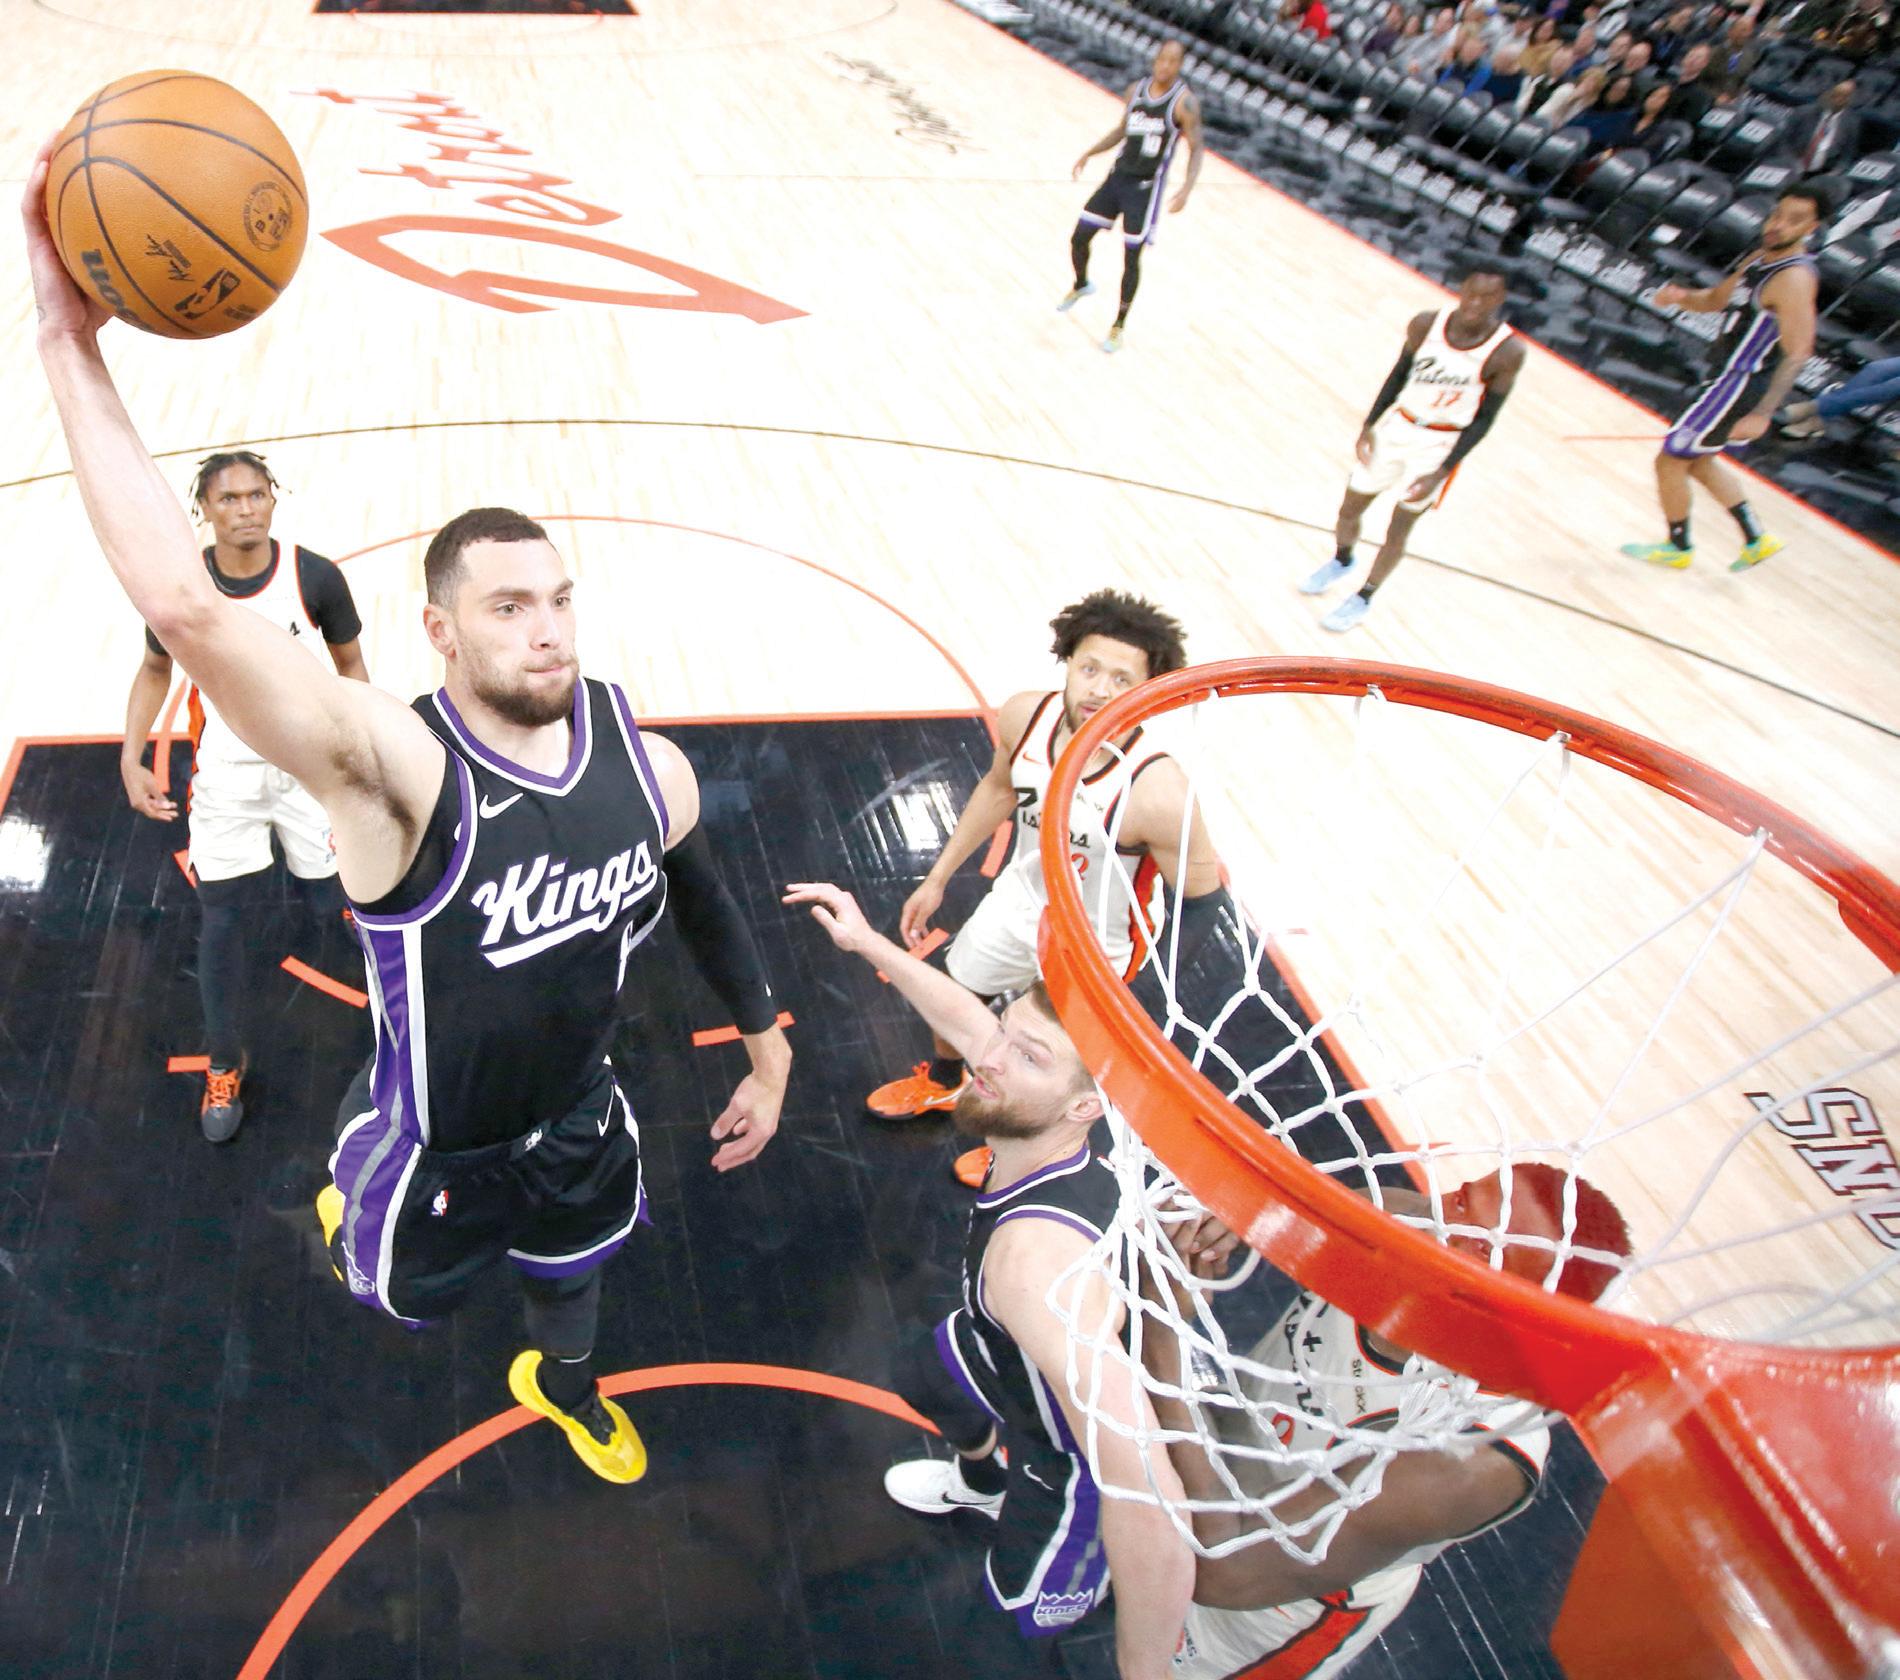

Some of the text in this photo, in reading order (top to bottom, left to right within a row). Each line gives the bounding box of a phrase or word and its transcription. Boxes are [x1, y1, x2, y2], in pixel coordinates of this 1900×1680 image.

[287, 88, 811, 325] Detroit
[470, 839, 658, 968] Kings
[1352, 1358, 1367, 1415] StckX
